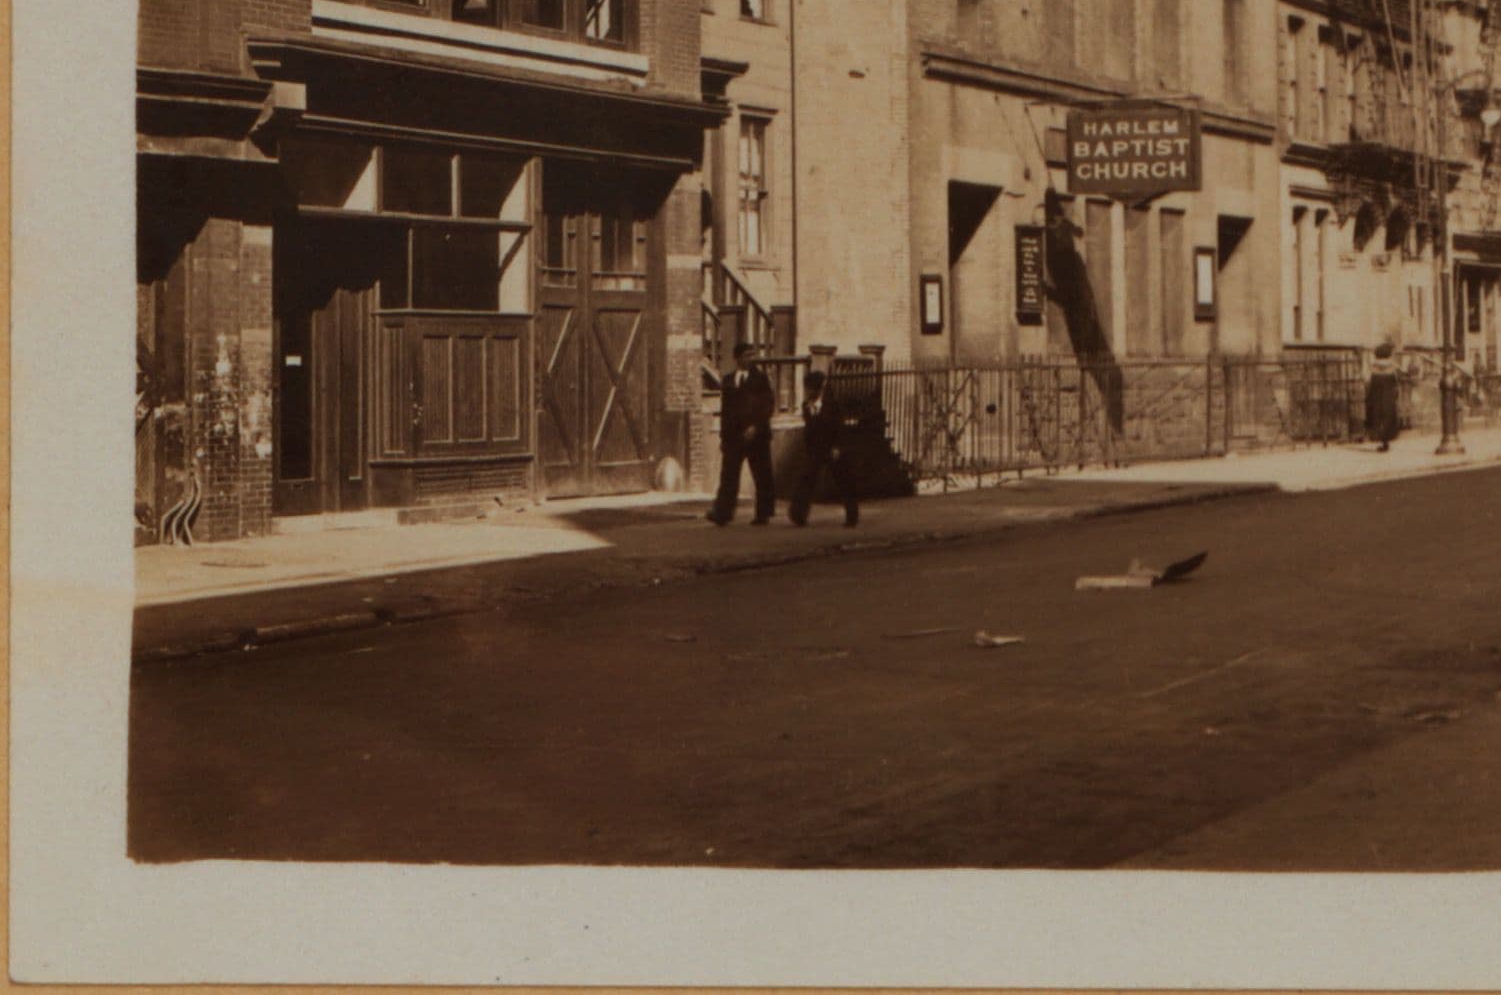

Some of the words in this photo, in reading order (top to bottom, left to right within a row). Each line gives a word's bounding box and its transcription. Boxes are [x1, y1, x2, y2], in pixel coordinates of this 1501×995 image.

[1082, 119, 1179, 136] HARLEM
[1073, 138, 1190, 158] BAPTIST
[1075, 160, 1187, 180] CHURCH
